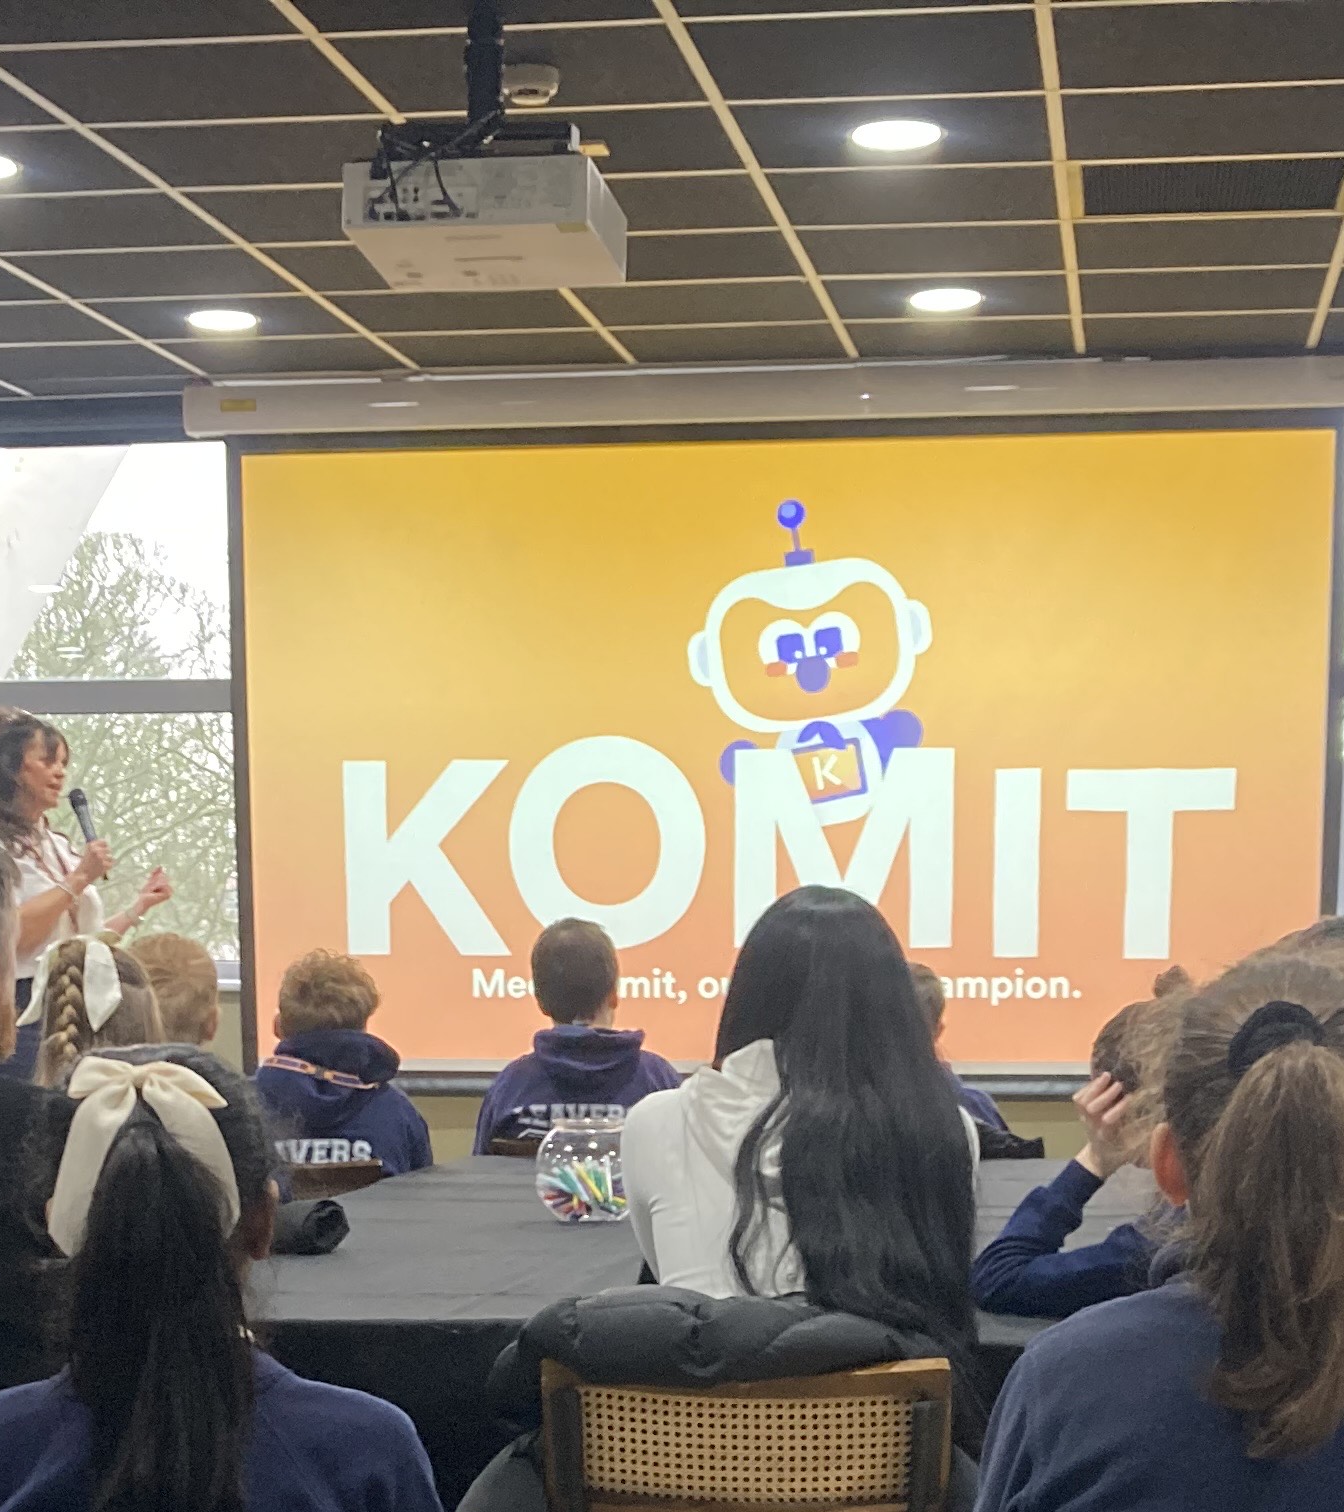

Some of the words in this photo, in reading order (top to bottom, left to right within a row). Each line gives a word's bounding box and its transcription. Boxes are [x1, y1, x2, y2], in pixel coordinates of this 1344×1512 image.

[811, 753, 843, 791] K
[341, 736, 1237, 959] KOMIT
[619, 967, 688, 1004] mit,
[939, 967, 1082, 1006] ampion.
